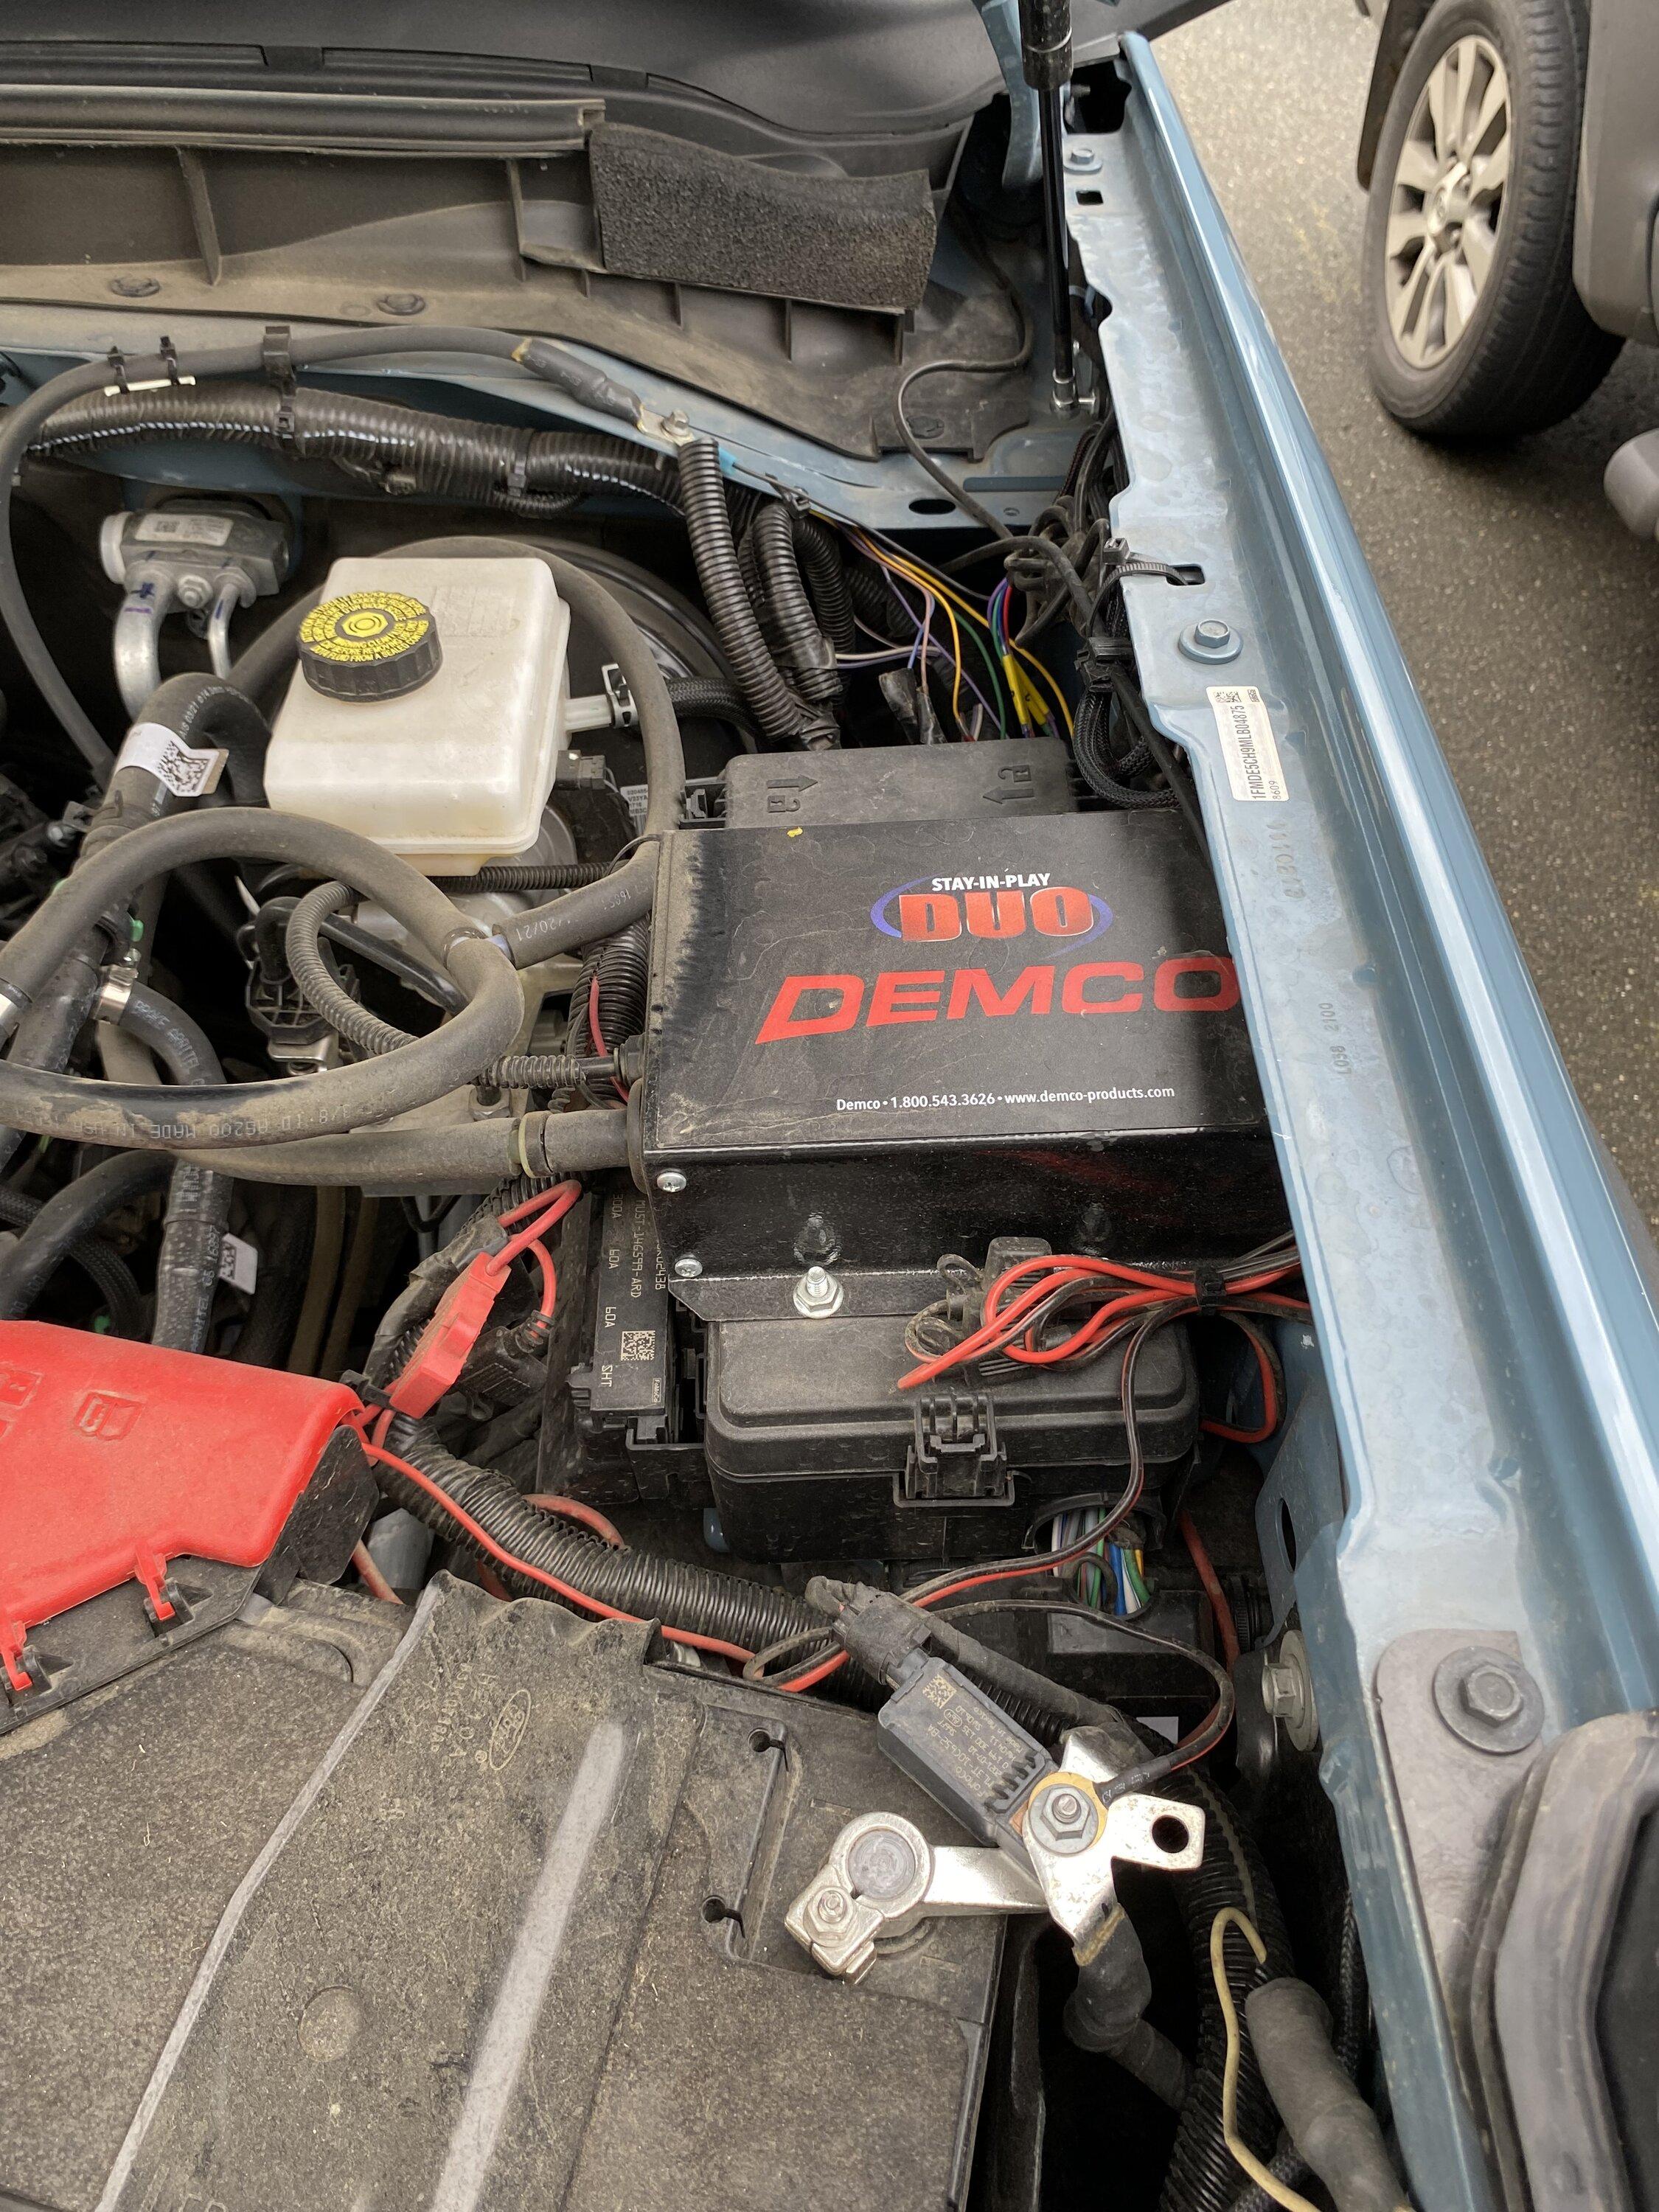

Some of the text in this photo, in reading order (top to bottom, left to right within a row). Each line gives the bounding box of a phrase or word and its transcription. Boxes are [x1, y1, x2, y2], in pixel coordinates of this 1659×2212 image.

[327, 651, 350, 662] FLUID
[350, 653, 375, 662] FROM
[1229, 704, 1267, 799] 1FMDE5CH9MLB04875
[1267, 780, 1282, 801] 8609
[931, 872, 1051, 891] STAY-IN-PLAY
[899, 886, 1095, 943] DUO
[755, 956, 1242, 1044] DEMCO
[836, 1085, 1175, 1111] Demco 1.800.543.3626 www.demco-products.com
[149, 1124, 198, 1140] MADE
[608, 1248, 620, 1270] 60A
[604, 1306, 616, 1329] 60A
[600, 1363, 613, 1388] SHT
[653, 1378, 662, 1404] FoMoCo
[973, 1706, 996, 1730] Mexico
[1006, 1736, 1023, 1753] Made
[955, 1766, 987, 1797] FoMoCo
